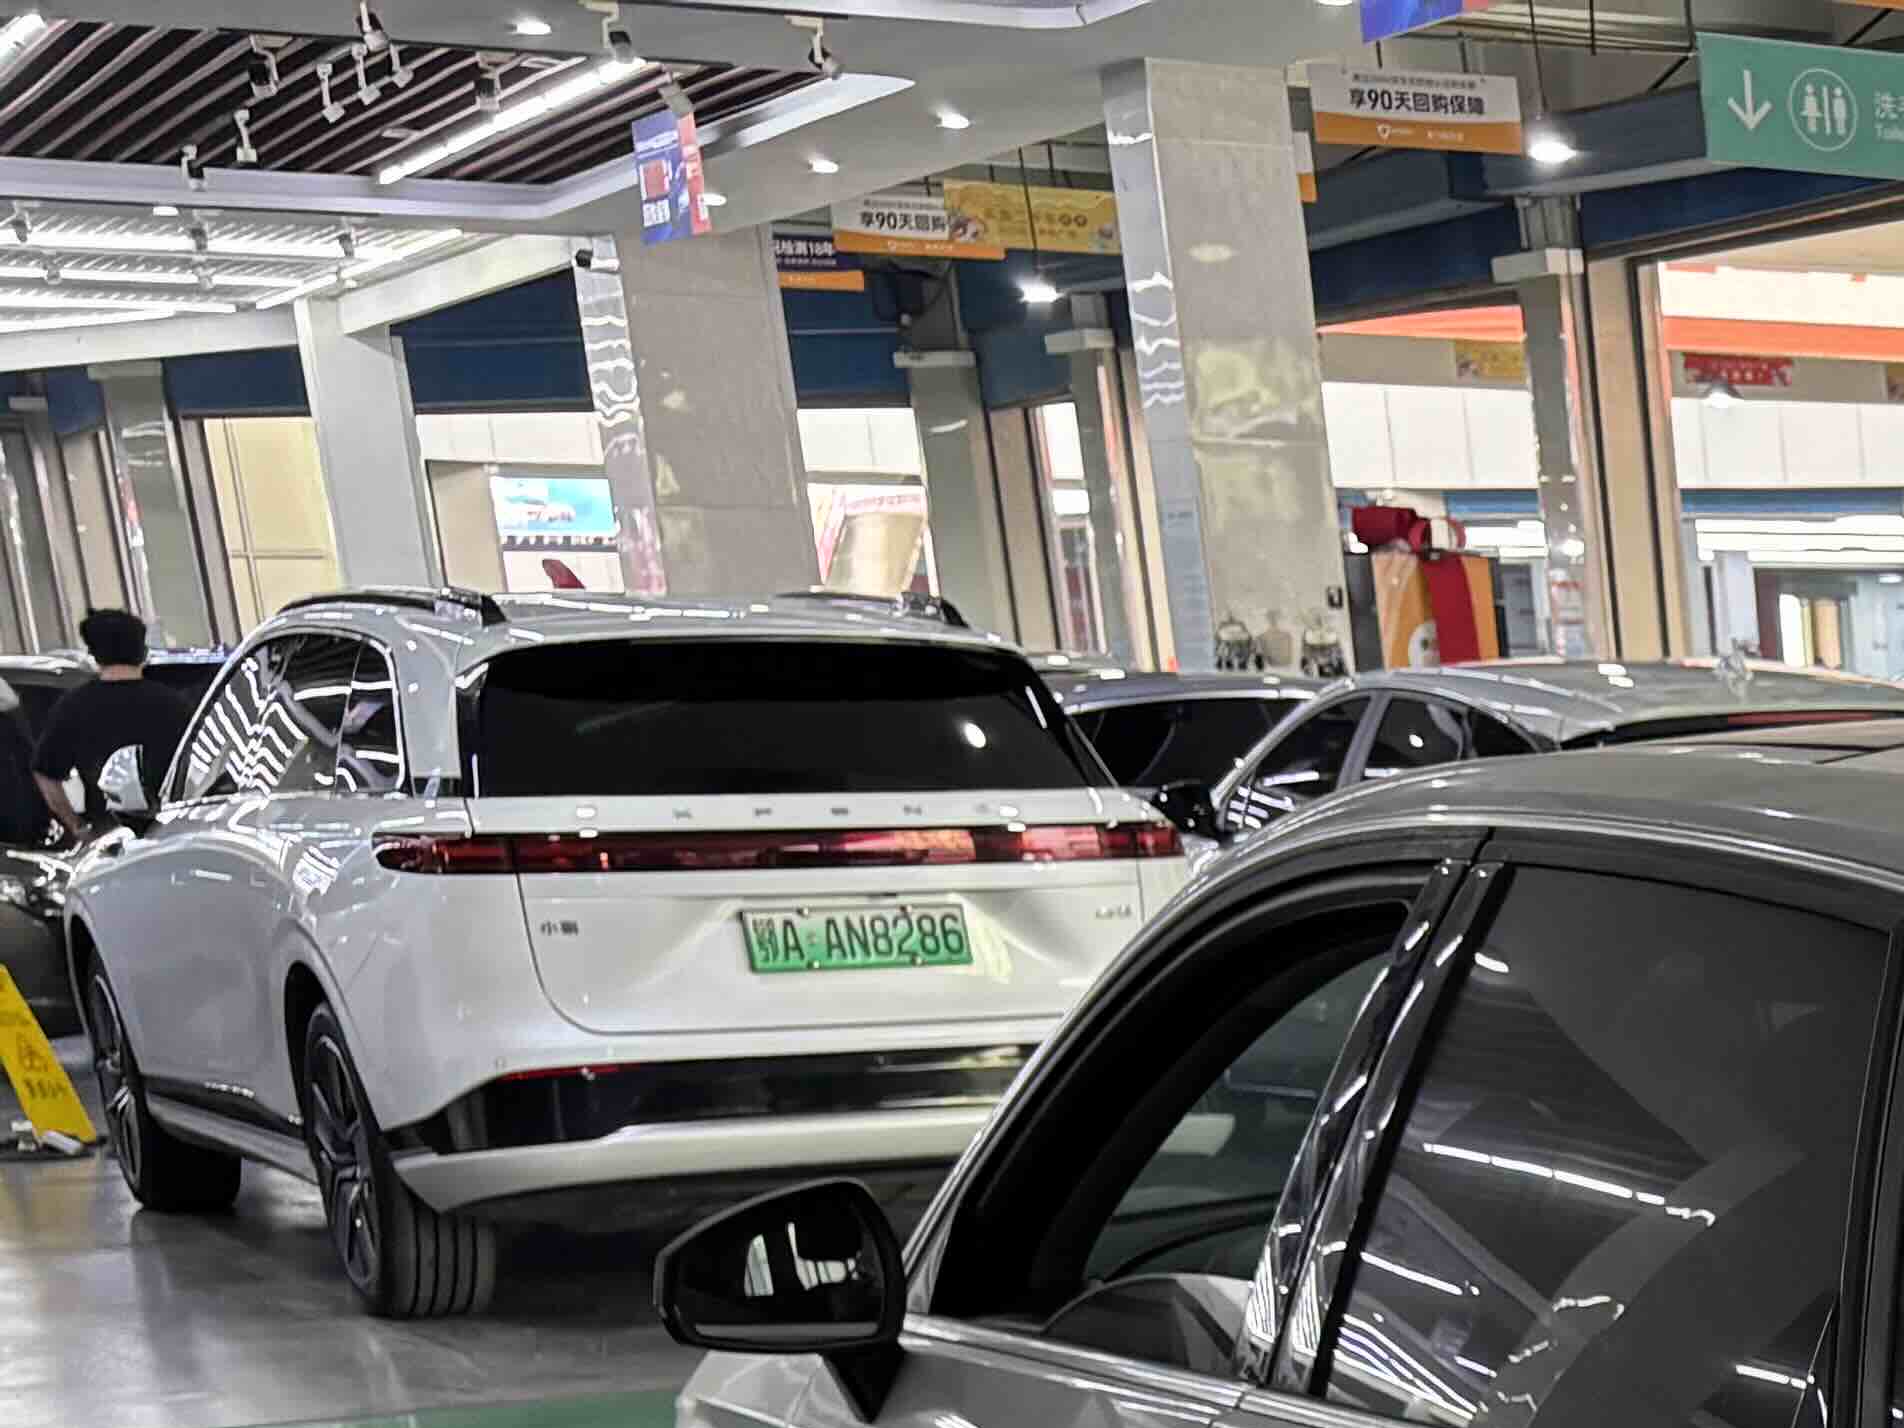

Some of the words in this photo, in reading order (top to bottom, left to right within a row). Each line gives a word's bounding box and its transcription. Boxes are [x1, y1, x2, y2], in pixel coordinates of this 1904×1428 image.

[1350, 87, 1486, 115] 享90天回购保障
